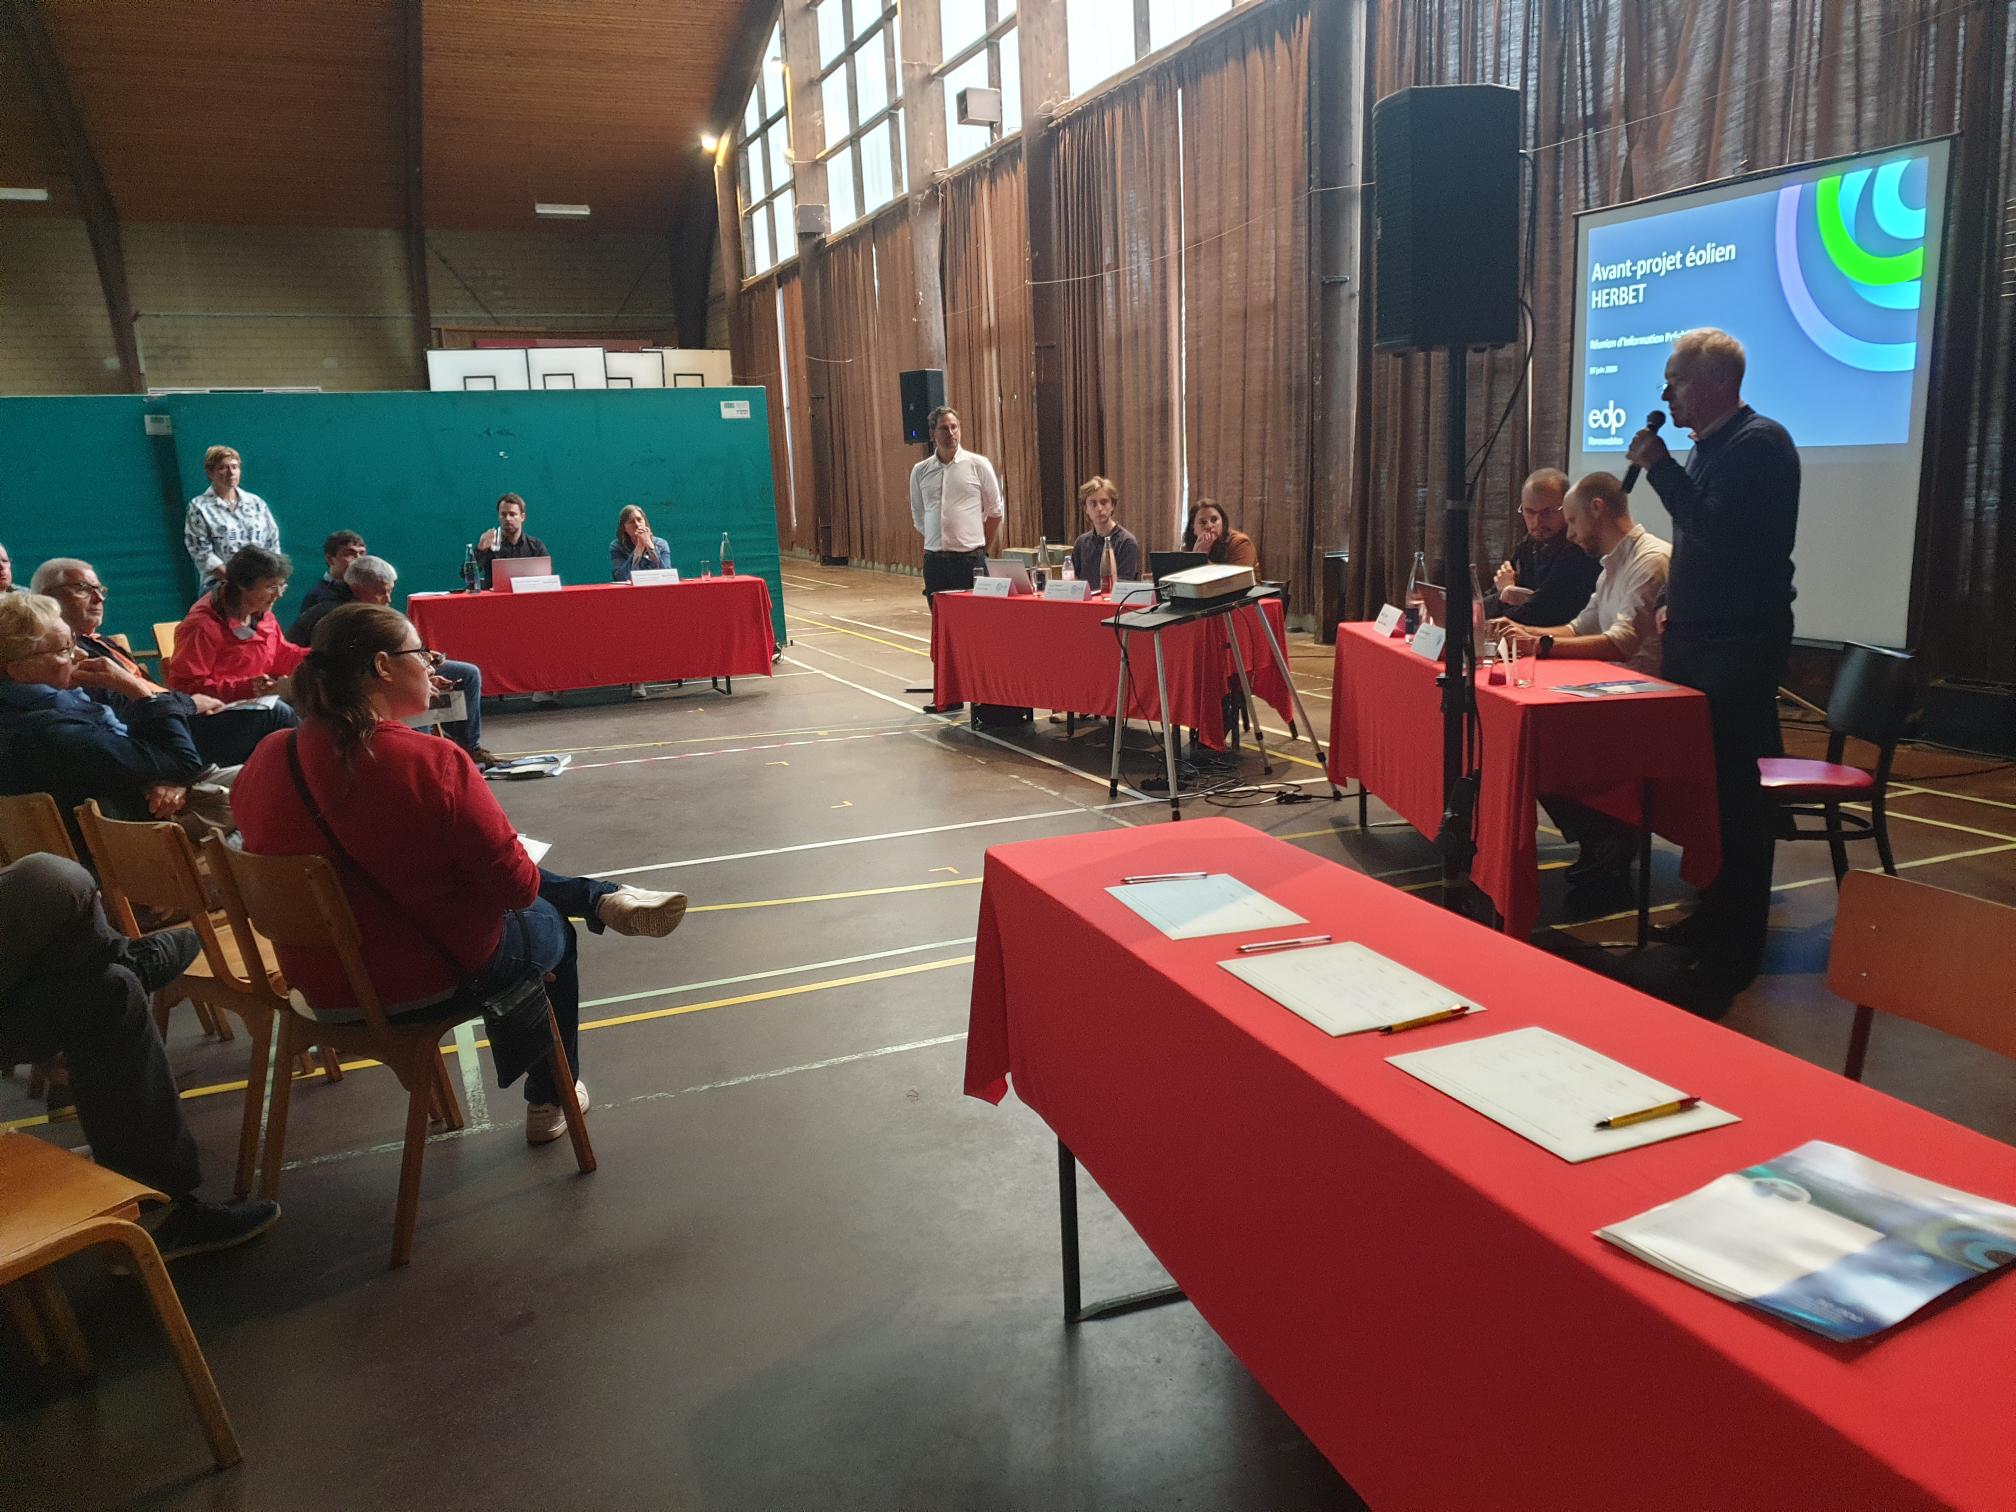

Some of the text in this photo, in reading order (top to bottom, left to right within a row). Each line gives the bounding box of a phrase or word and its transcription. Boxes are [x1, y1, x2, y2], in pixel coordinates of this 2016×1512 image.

[1592, 242, 1736, 283] Avant-projet éolien
[1592, 283, 1647, 309] HERBET
[1588, 399, 1627, 436] edp
